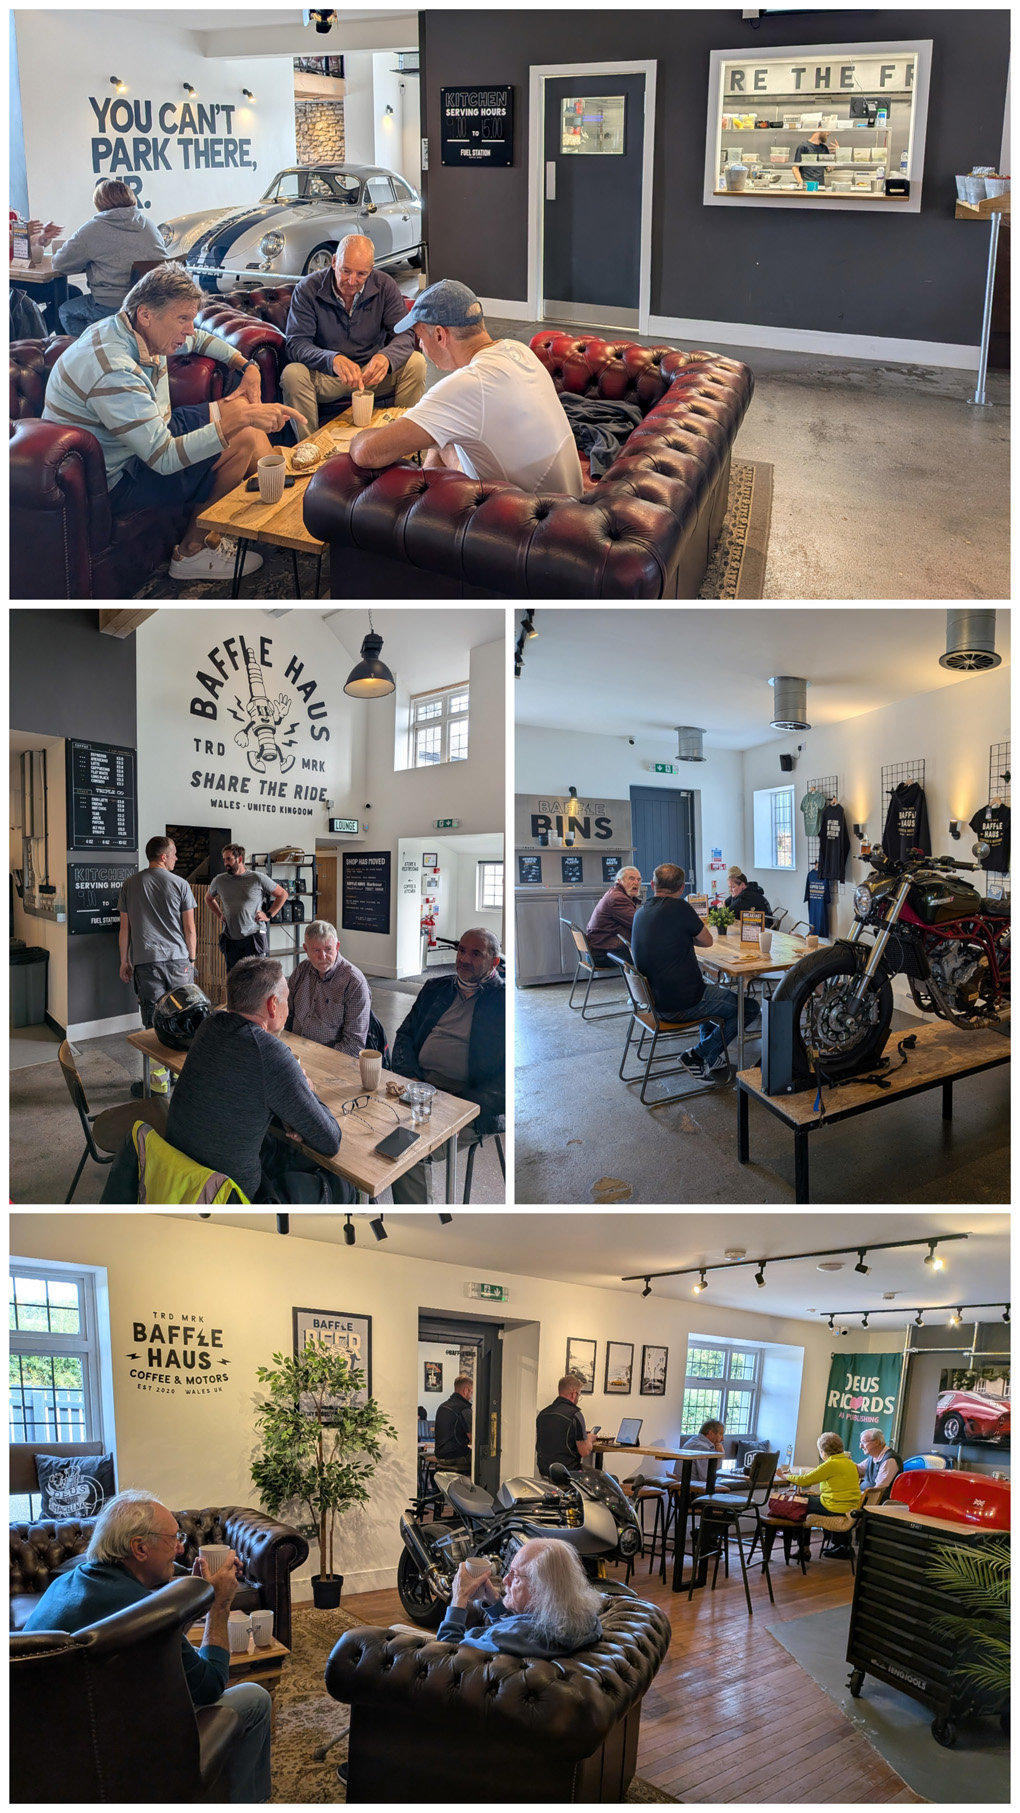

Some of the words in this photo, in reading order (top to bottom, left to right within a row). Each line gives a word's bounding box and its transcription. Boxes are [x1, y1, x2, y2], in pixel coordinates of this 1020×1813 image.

[730, 69, 768, 91] RE
[791, 66, 855, 89] THE
[446, 92, 507, 107] KITCHEN
[88, 96, 152, 134] YOU
[158, 102, 235, 134] CAN'T
[446, 108, 479, 116] SERVING
[480, 108, 506, 116] HOURS
[92, 138, 172, 173] PARK
[177, 138, 257, 172] THERE,
[95, 175, 152, 209] R.
[190, 635, 272, 720] BAFFLE
[284, 655, 330, 742] HAUS
[194, 738, 225, 756] TRD
[302, 758, 325, 772] MRK
[190, 770, 251, 794] SHARE
[260, 780, 288, 798] THE
[210, 799, 240, 810] WALES
[247, 803, 276, 813] UNITED
[280, 806, 313, 816] KINGDOM
[538, 800, 605, 816] BAFFLE
[335, 821, 356, 830] LOUNGE
[531, 814, 613, 840] BINS
[74, 868, 134, 881] KITCHEN
[153, 1312, 174, 1320] TRD
[182, 1314, 204, 1323] MRK
[313, 1319, 353, 1331] BAFFLE
[133, 1322, 223, 1348] BAFFLE
[148, 1348, 211, 1370] HAUS
[130, 1369, 171, 1383] COFFEE
[174, 1376, 182, 1384] &
[186, 1374, 228, 1385] MOTORS
[846, 1413, 879, 1423] PUBLISHING
[54, 1485, 86, 1498] DEUS
[52, 1502, 85, 1514] MACHINA
